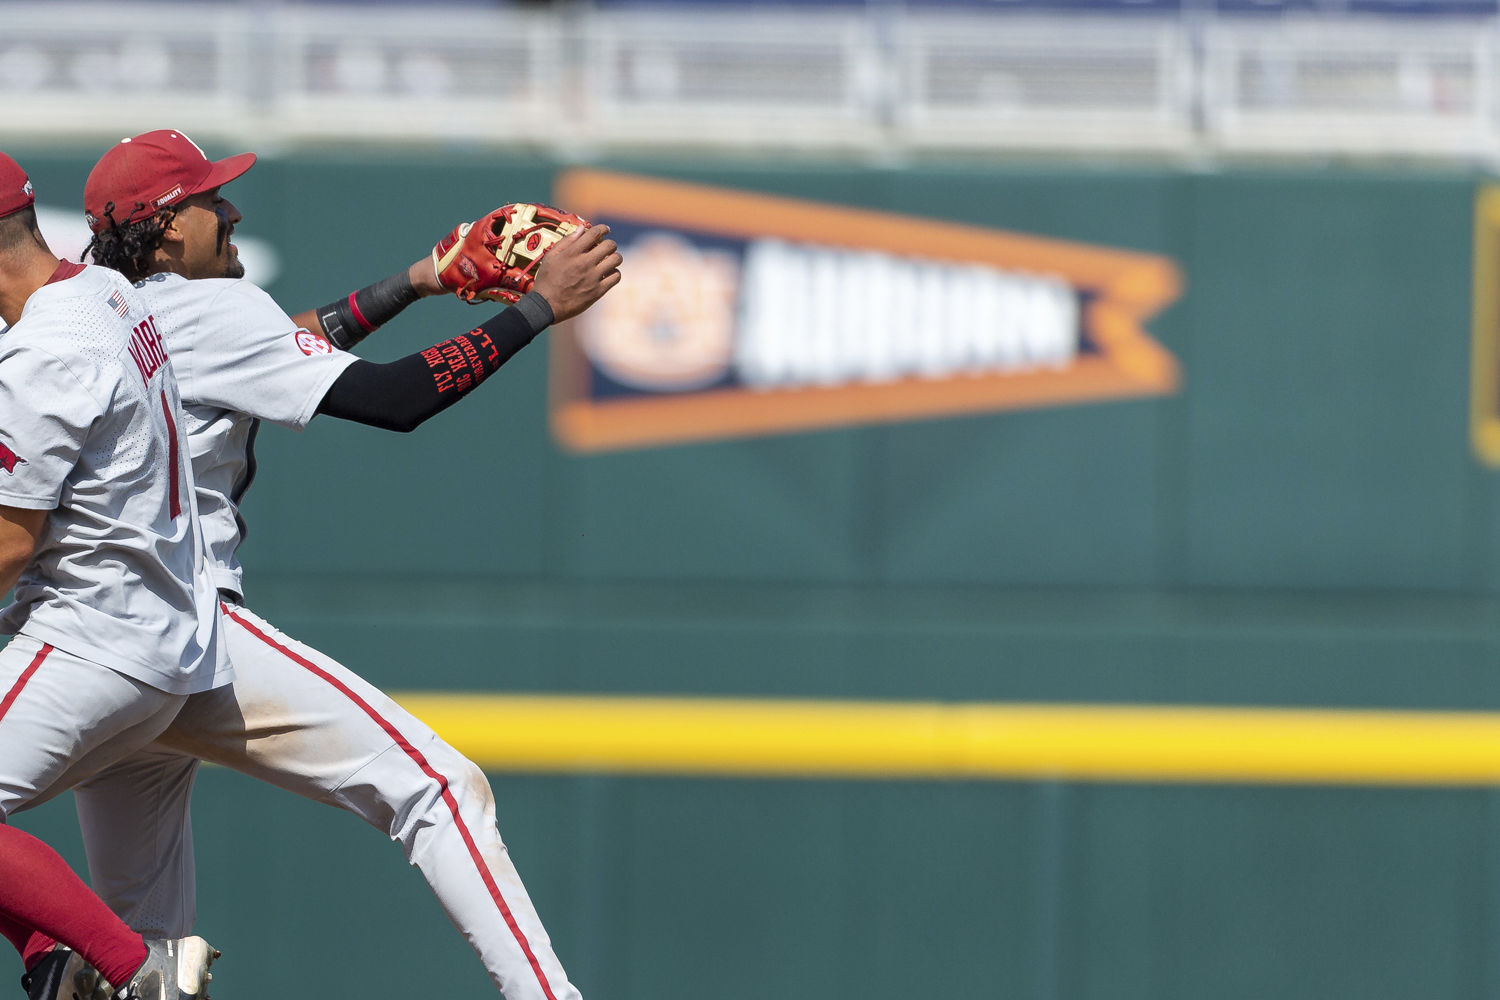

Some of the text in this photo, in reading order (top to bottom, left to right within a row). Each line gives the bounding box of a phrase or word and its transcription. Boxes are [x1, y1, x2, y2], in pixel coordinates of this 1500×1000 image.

[157, 187, 182, 206] EQUALITY
[433, 370, 454, 393] FLY
[161, 389, 181, 521] 1
